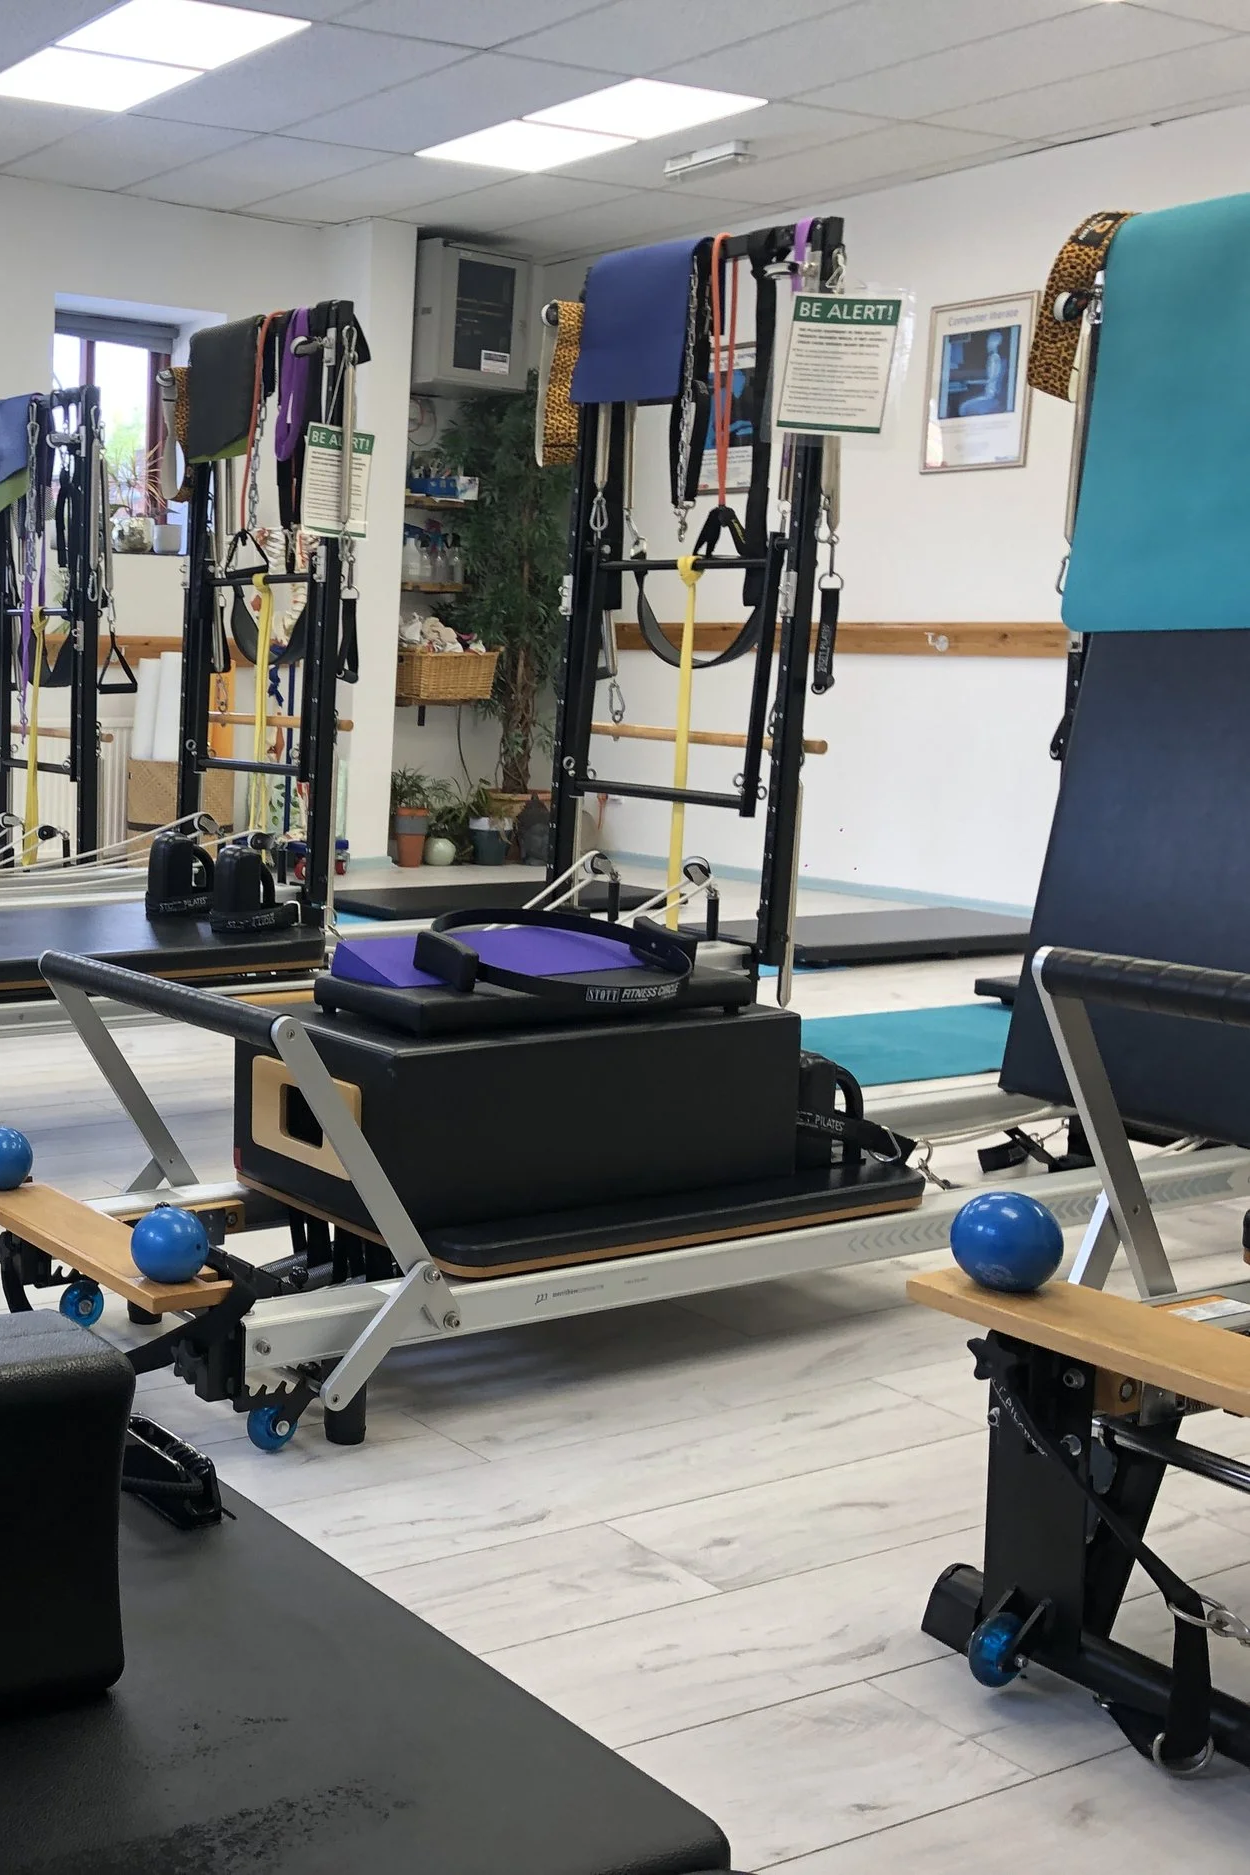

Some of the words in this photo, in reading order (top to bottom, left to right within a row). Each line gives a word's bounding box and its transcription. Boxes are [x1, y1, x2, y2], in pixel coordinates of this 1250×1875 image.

[799, 301, 823, 318] BE
[827, 303, 894, 320] ALERT!
[311, 430, 327, 444] BE
[588, 988, 618, 1001] STOTT
[622, 986, 658, 999] FITNESS
[657, 982, 680, 996] CIRCLE
[814, 1114, 846, 1132] PILATES
